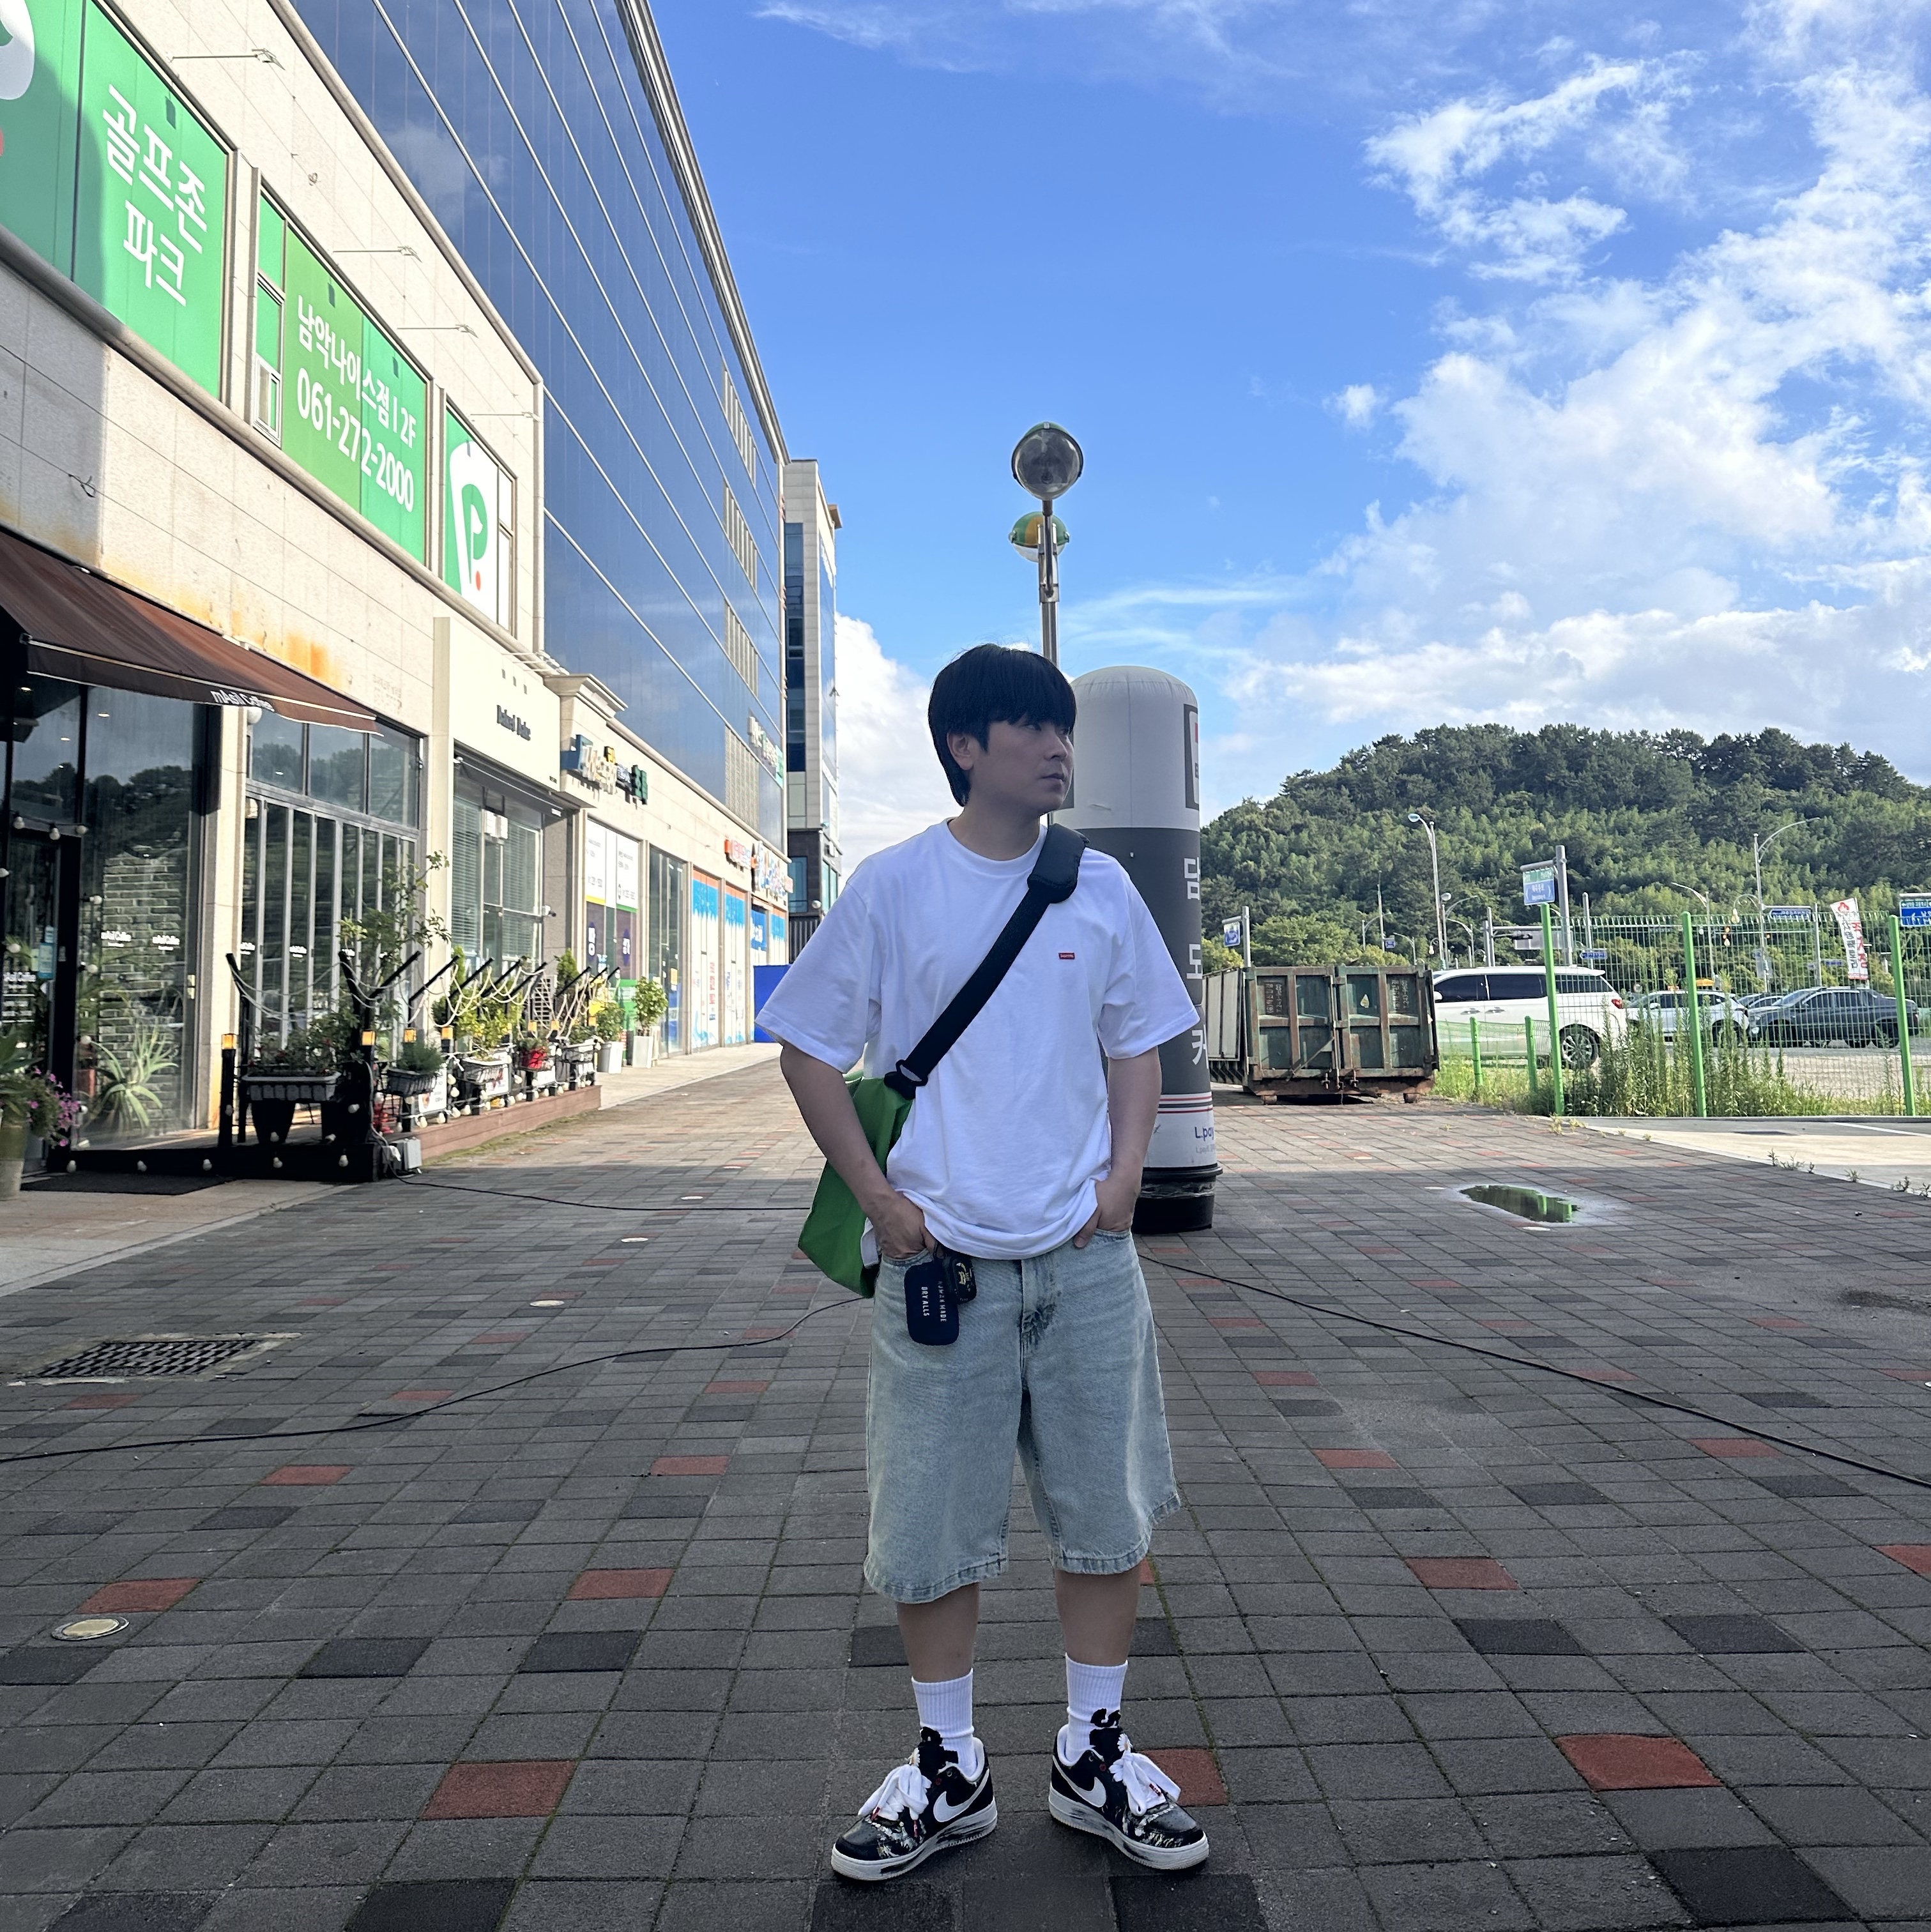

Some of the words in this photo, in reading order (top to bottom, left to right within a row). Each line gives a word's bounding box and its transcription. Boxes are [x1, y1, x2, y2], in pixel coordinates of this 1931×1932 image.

[103, 84, 208, 254] 골프존
[123, 199, 187, 307] 파크
[296, 367, 414, 513] 061-272-2000
[401, 407, 416, 449] 2F
